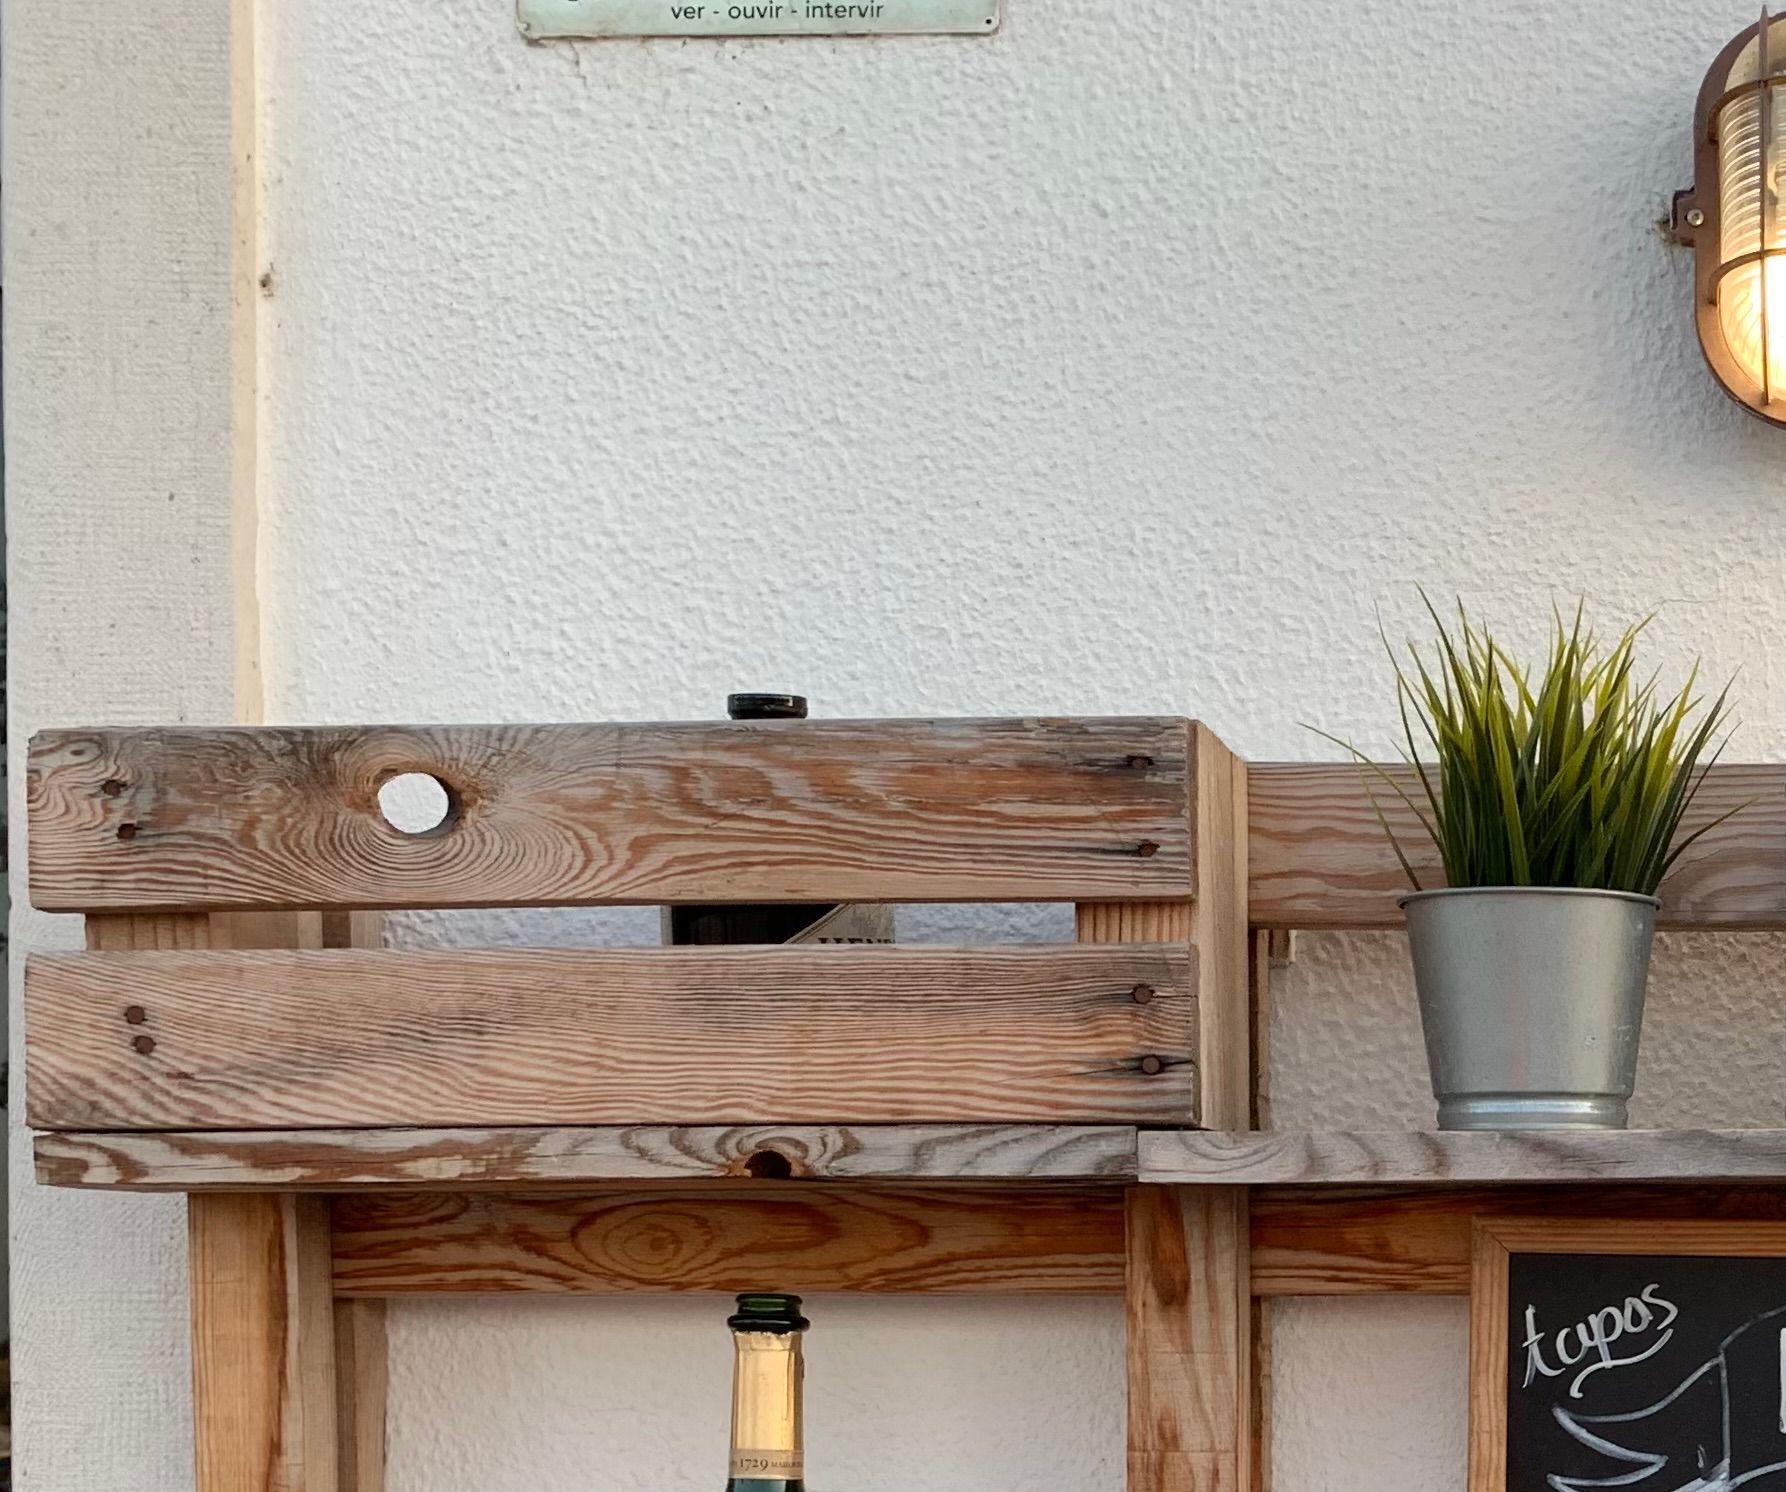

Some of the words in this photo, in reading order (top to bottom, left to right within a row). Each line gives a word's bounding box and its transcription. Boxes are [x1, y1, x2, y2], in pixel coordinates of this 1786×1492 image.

[670, 3, 704, 20] ver
[728, 1, 783, 20] ouvir
[805, 0, 884, 19] intervir
[740, 1458, 769, 1471] 1729
